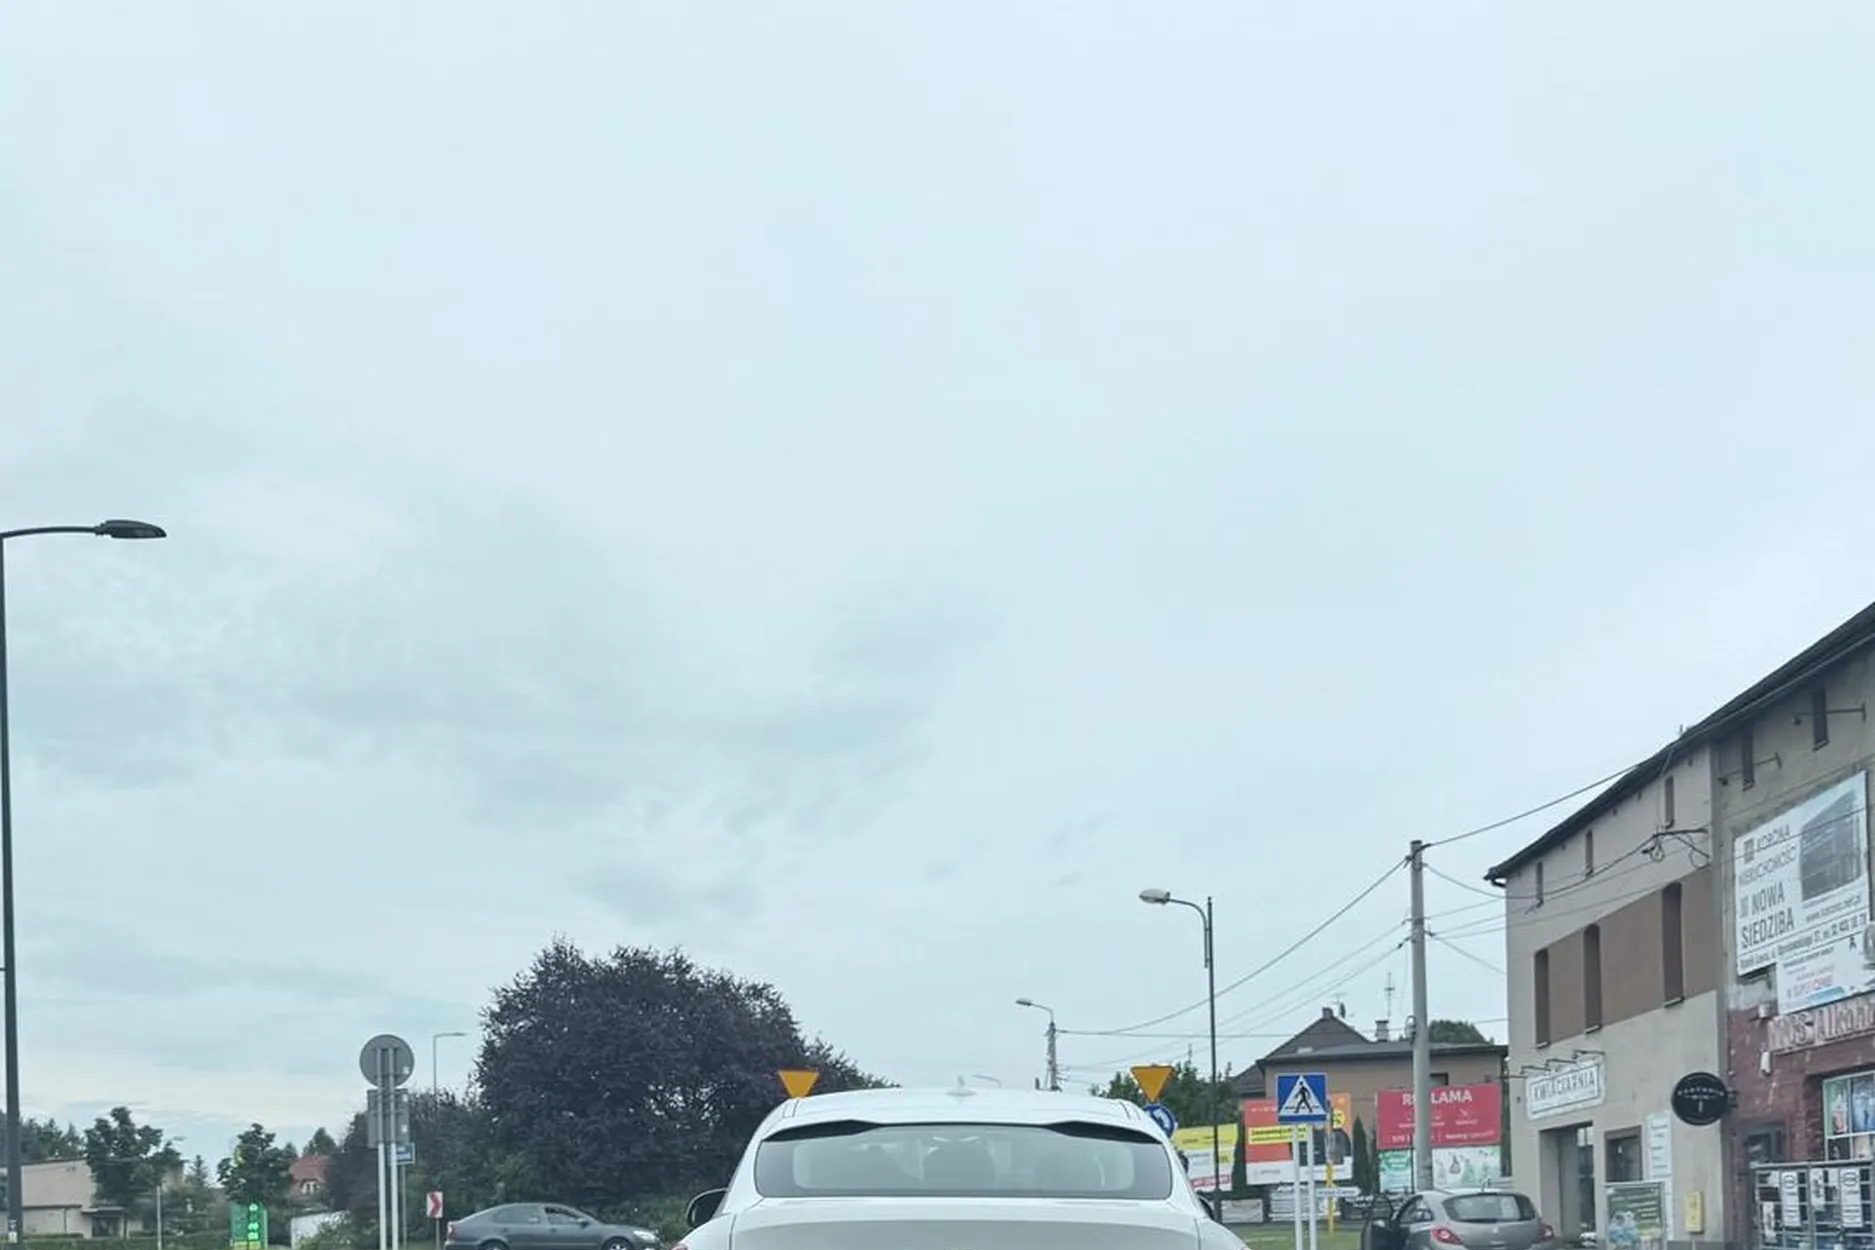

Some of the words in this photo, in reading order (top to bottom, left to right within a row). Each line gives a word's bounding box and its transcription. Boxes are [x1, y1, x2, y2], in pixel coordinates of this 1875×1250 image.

[1751, 881, 1784, 917] NOWA
[1741, 908, 1795, 949] SIEDZIBA
[1402, 1088, 1473, 1106] RLAMA
